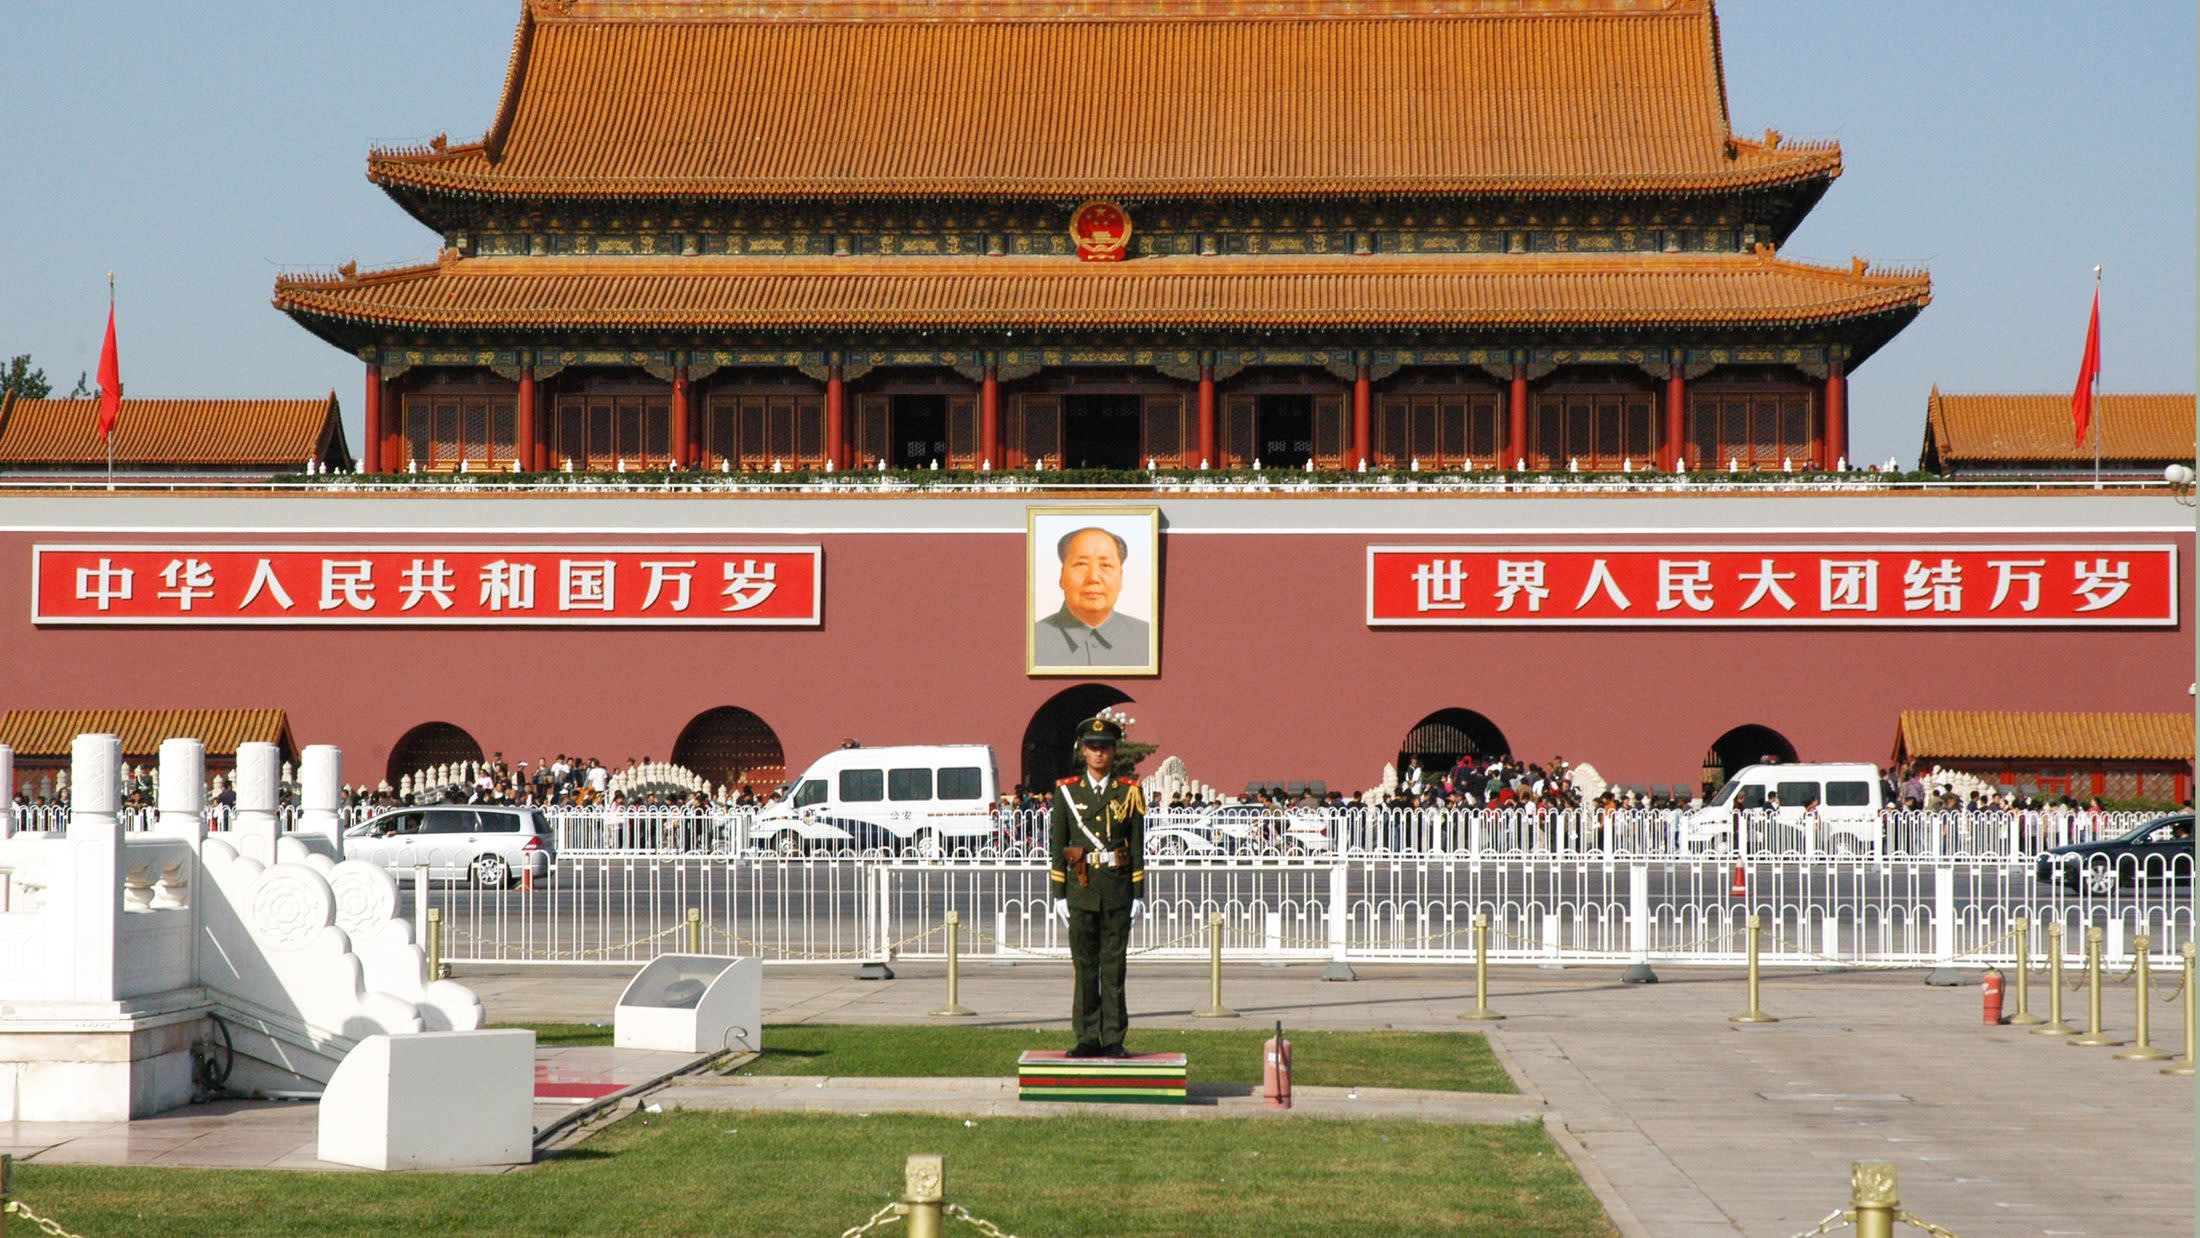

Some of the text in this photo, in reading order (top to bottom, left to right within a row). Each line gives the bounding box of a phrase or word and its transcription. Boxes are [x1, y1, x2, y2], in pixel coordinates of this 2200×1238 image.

[75, 558, 778, 611] 中华人民共和国万岁
[1411, 558, 2130, 612] 世界人民大团结万岁
